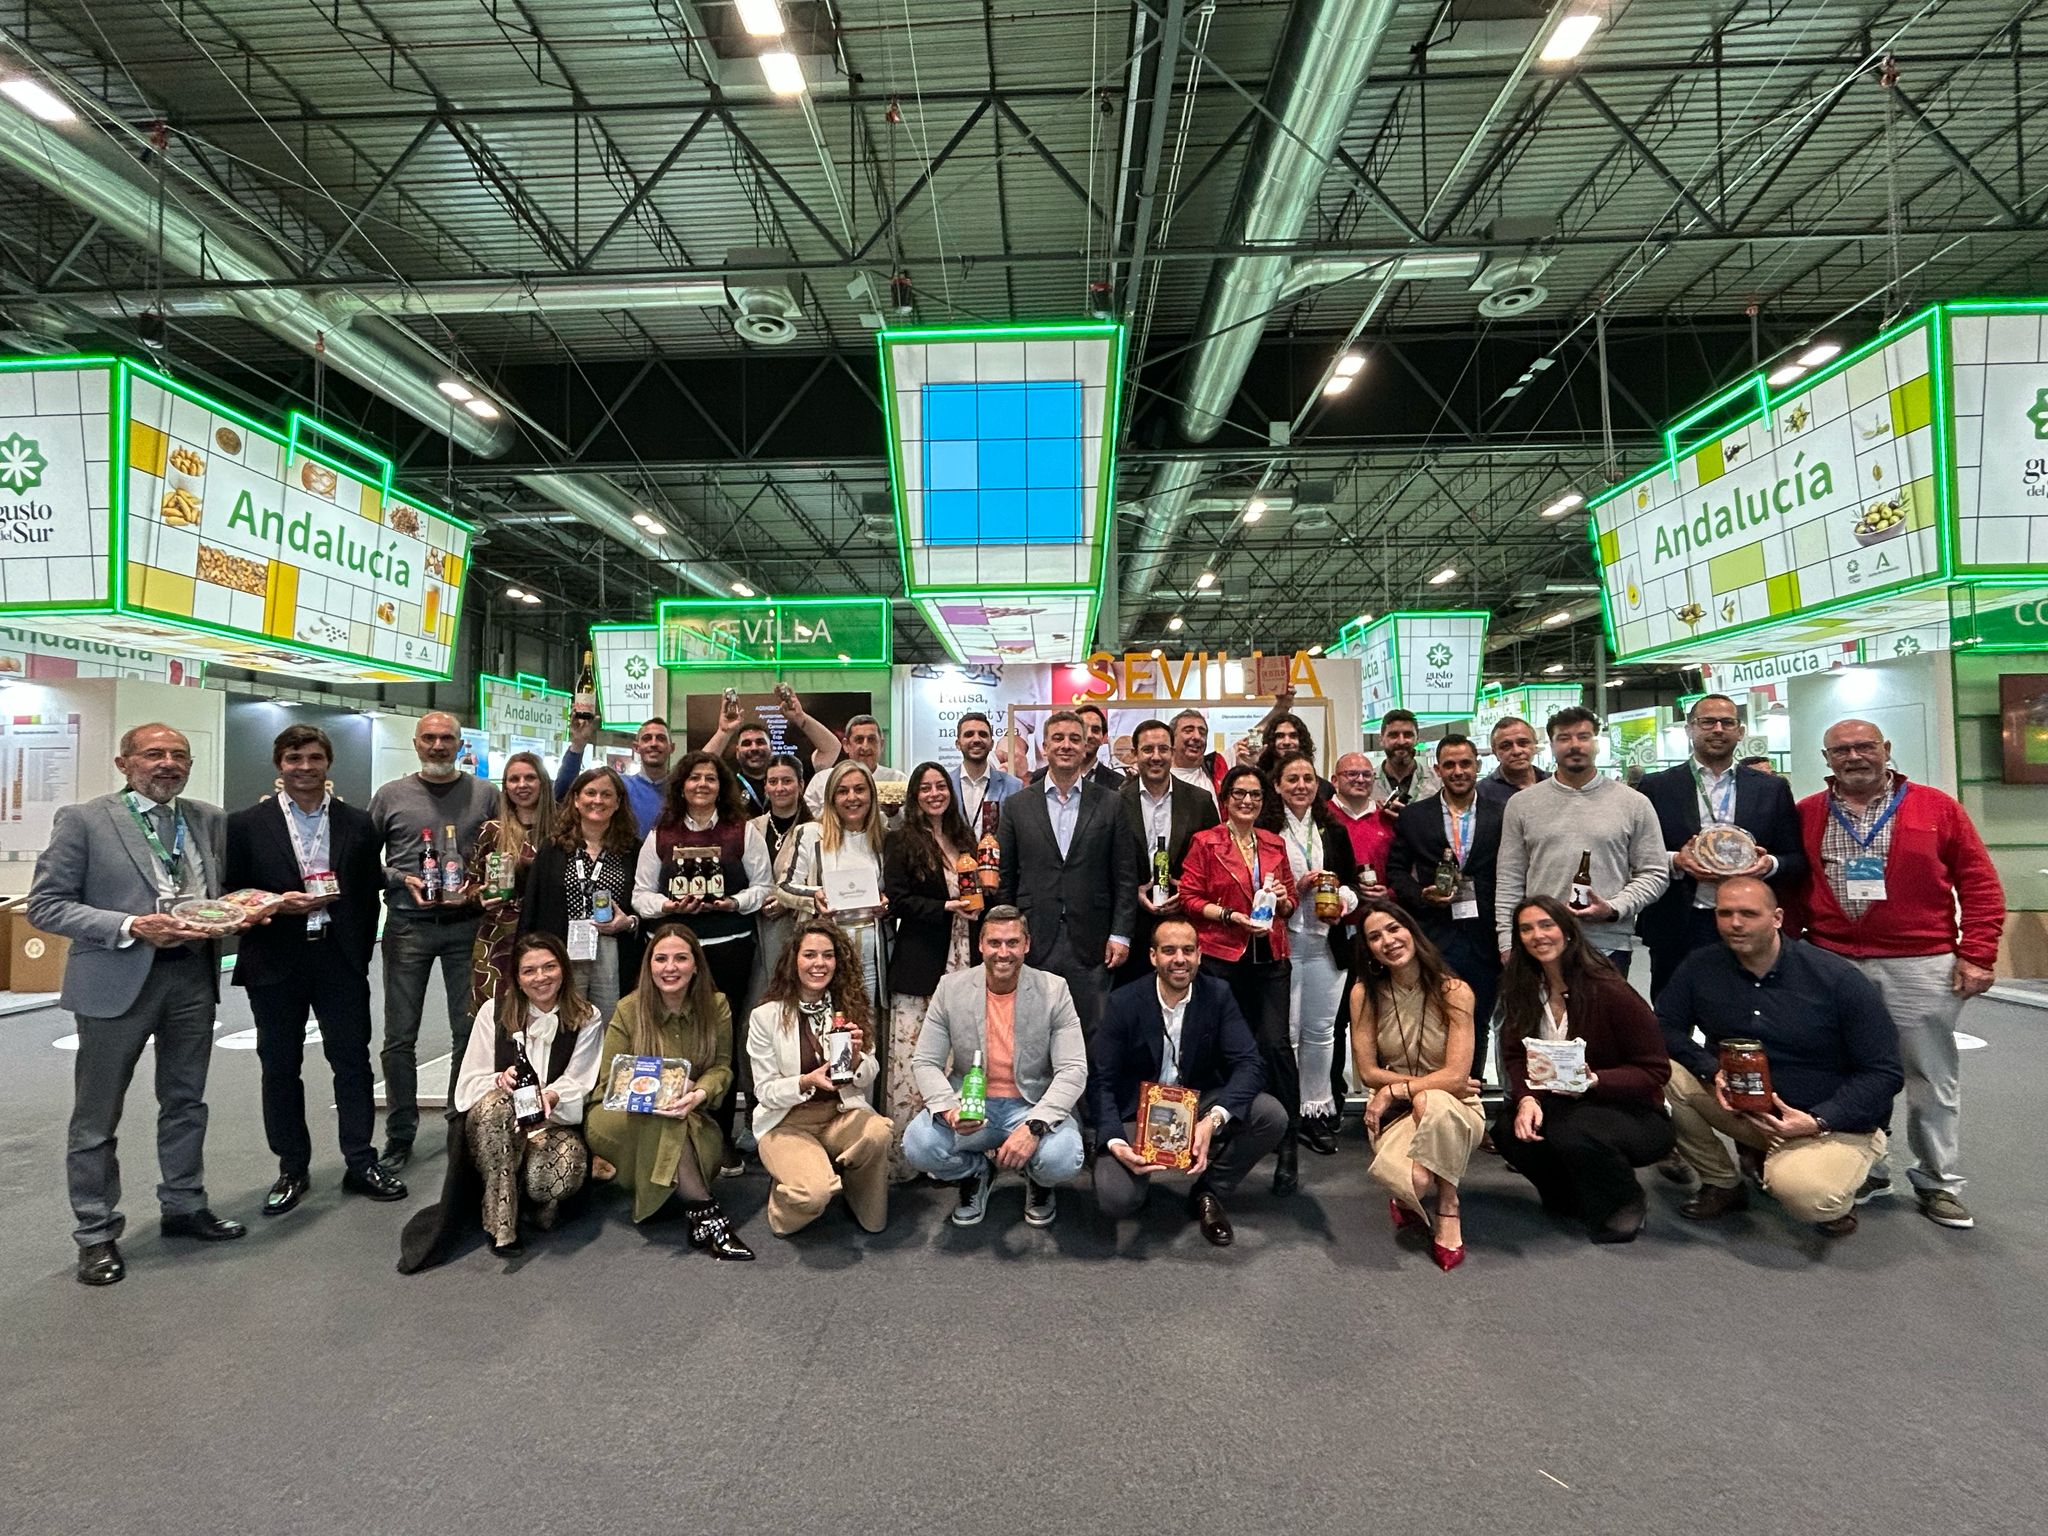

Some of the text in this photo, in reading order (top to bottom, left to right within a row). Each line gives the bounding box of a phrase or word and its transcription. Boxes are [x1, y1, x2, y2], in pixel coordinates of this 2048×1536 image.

[0, 500, 52, 529] usto
[1653, 451, 1834, 565] Andalucía
[13, 521, 54, 543] Sur
[227, 489, 410, 588] Andalucía
[1425, 671, 1453, 683] gusto
[1434, 679, 1453, 689] Sur
[625, 682, 651, 693] gusto
[633, 691, 651, 700] Sur
[505, 703, 553, 725] Andalucía
[938, 707, 1006, 722] cont y
[938, 725, 1021, 738] naleza
